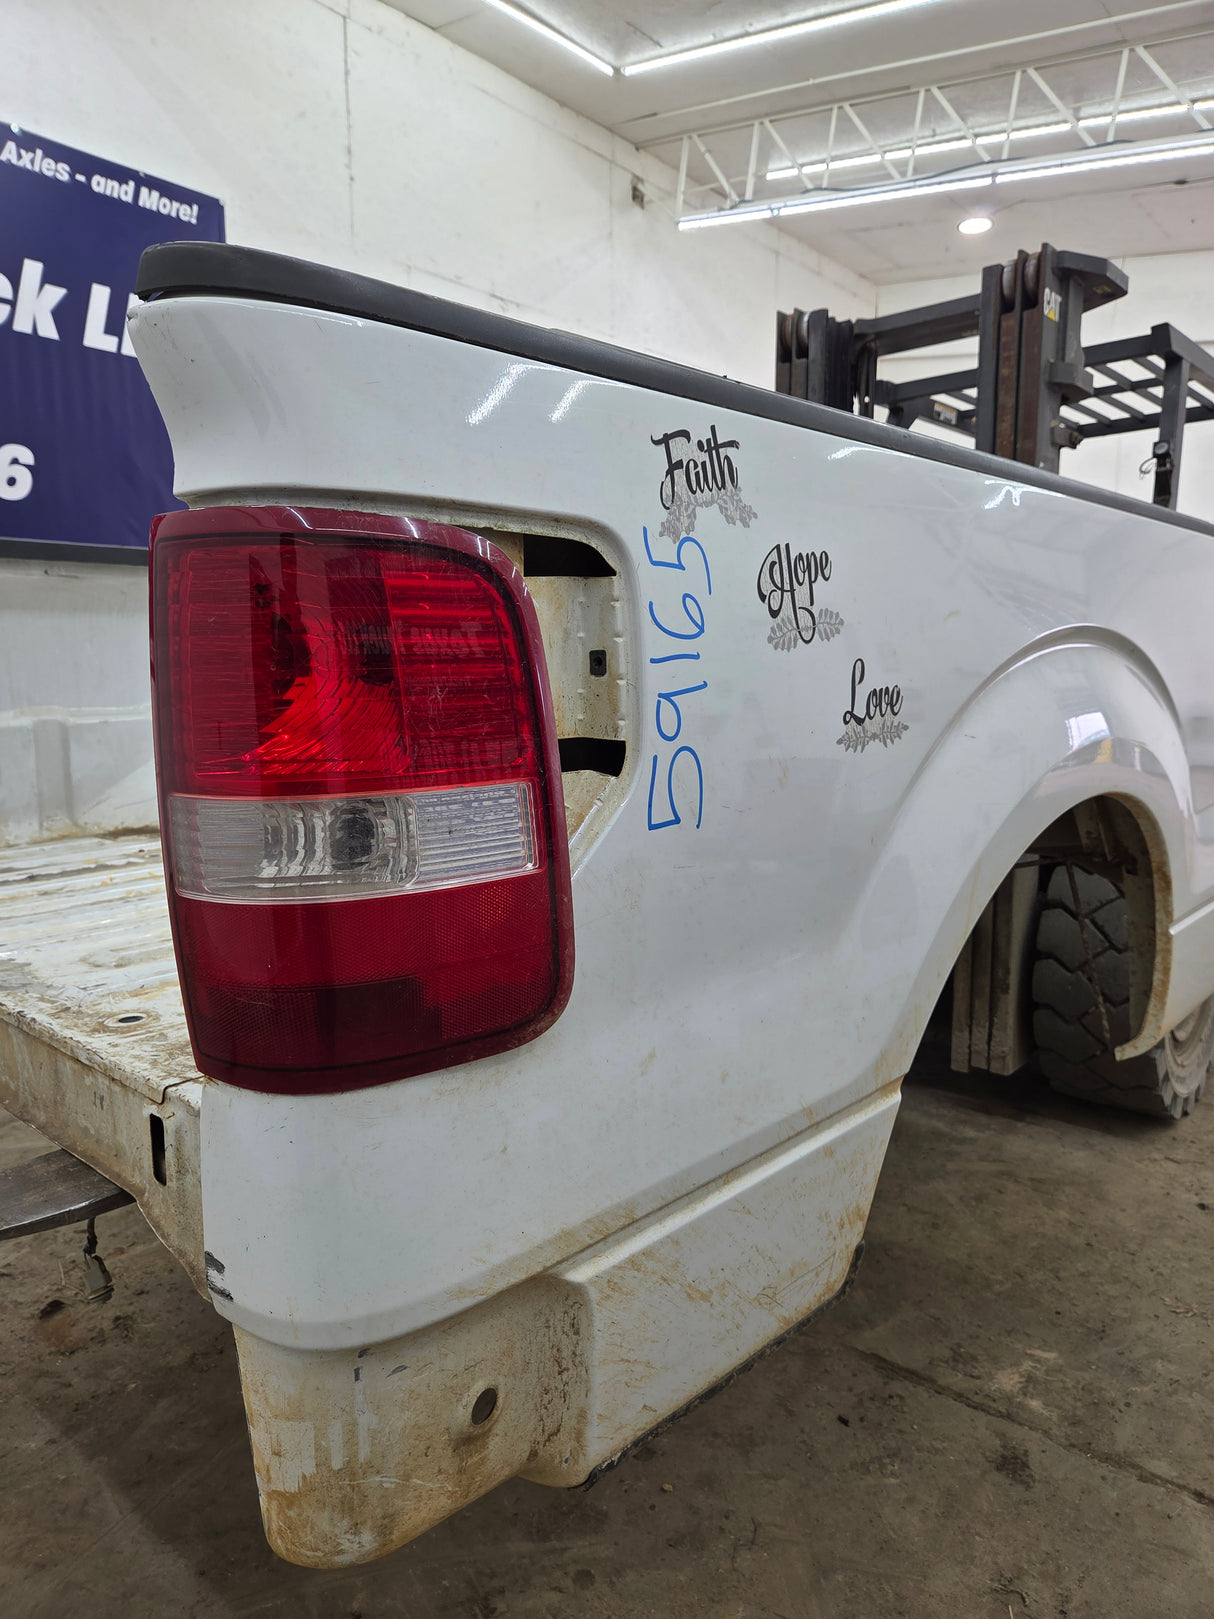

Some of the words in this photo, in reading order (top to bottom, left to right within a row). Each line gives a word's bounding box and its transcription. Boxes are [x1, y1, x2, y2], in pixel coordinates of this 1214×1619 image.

[0, 140, 71, 183] Axles
[91, 174, 135, 205] and
[138, 186, 199, 225] More!
[1044, 287, 1062, 323] CAT
[650, 424, 740, 511] Faith
[757, 542, 832, 645] Hope
[643, 526, 713, 831] 59165
[843, 657, 904, 726] Love
